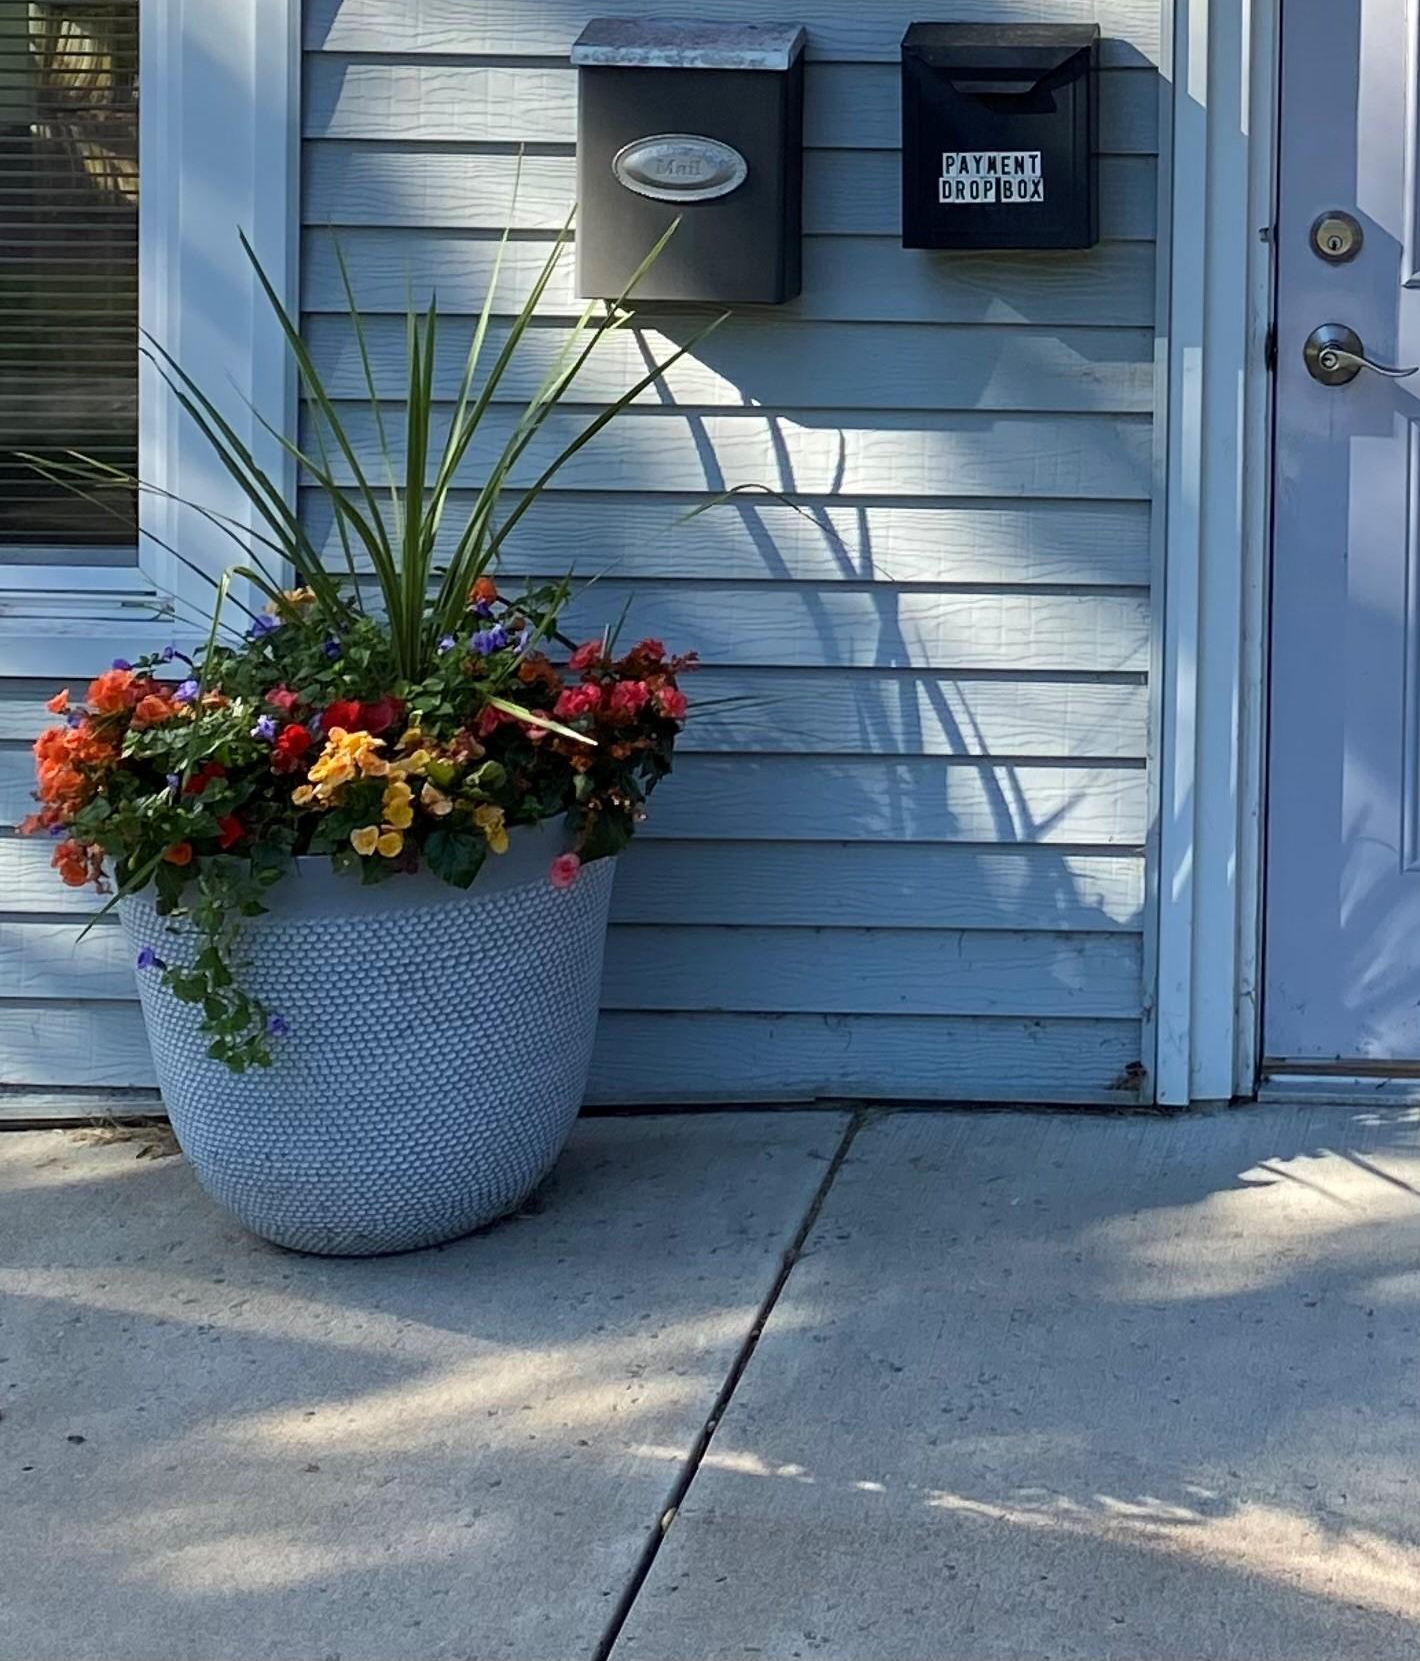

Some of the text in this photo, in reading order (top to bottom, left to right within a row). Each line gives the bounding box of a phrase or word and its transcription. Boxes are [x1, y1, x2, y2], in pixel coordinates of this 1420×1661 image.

[655, 158, 702, 176] Mail
[944, 154, 1039, 175] PAYMENT
[941, 179, 1043, 200] DROP BOX
